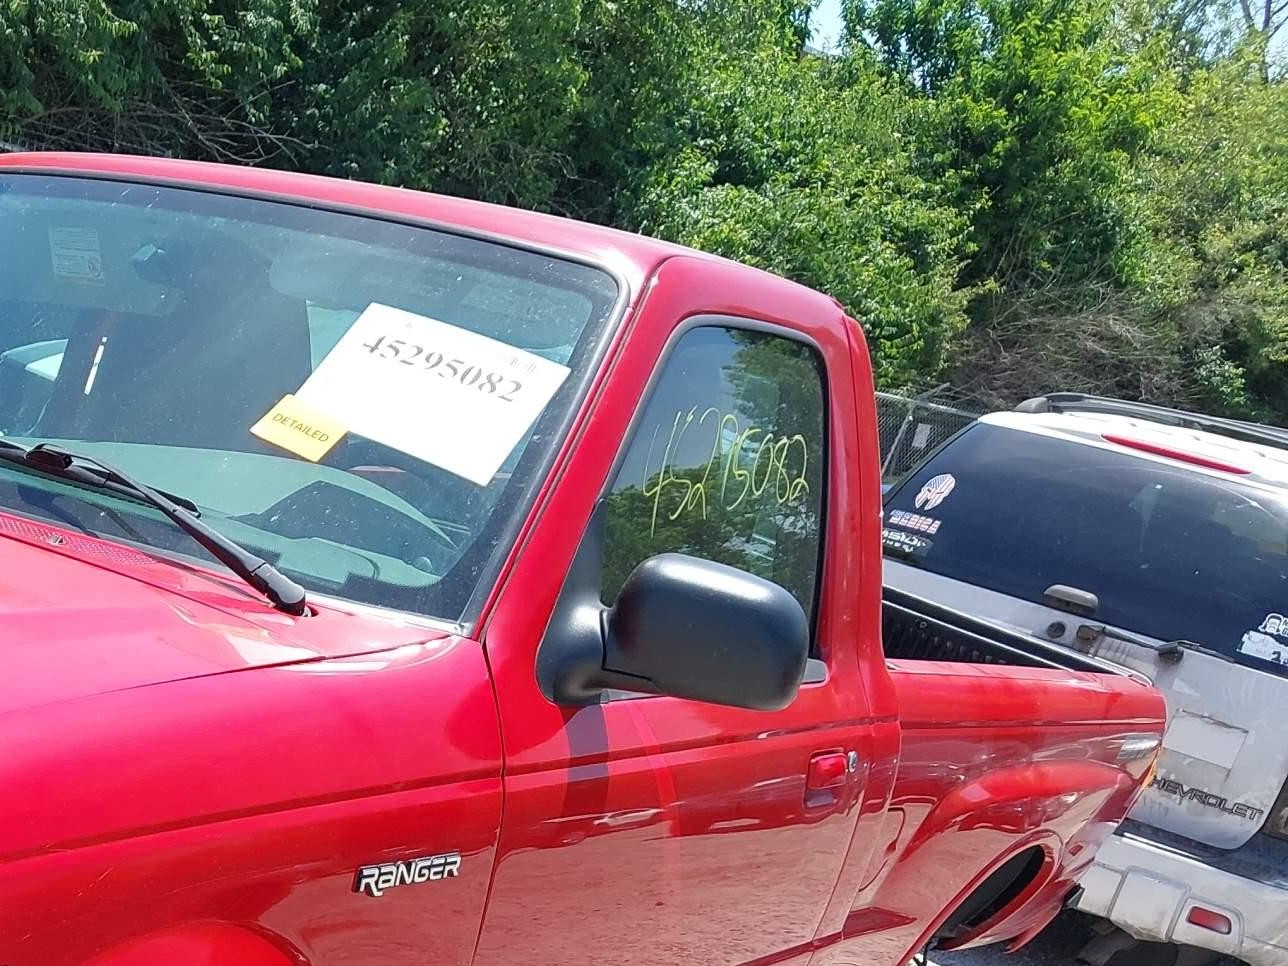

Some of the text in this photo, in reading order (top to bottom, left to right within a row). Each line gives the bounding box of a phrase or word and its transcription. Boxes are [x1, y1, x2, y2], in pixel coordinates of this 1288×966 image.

[362, 335, 523, 402] 45295082
[272, 412, 329, 443] DETAILED
[642, 405, 810, 538] 45295082
[1148, 775, 1264, 821] HEVROLET
